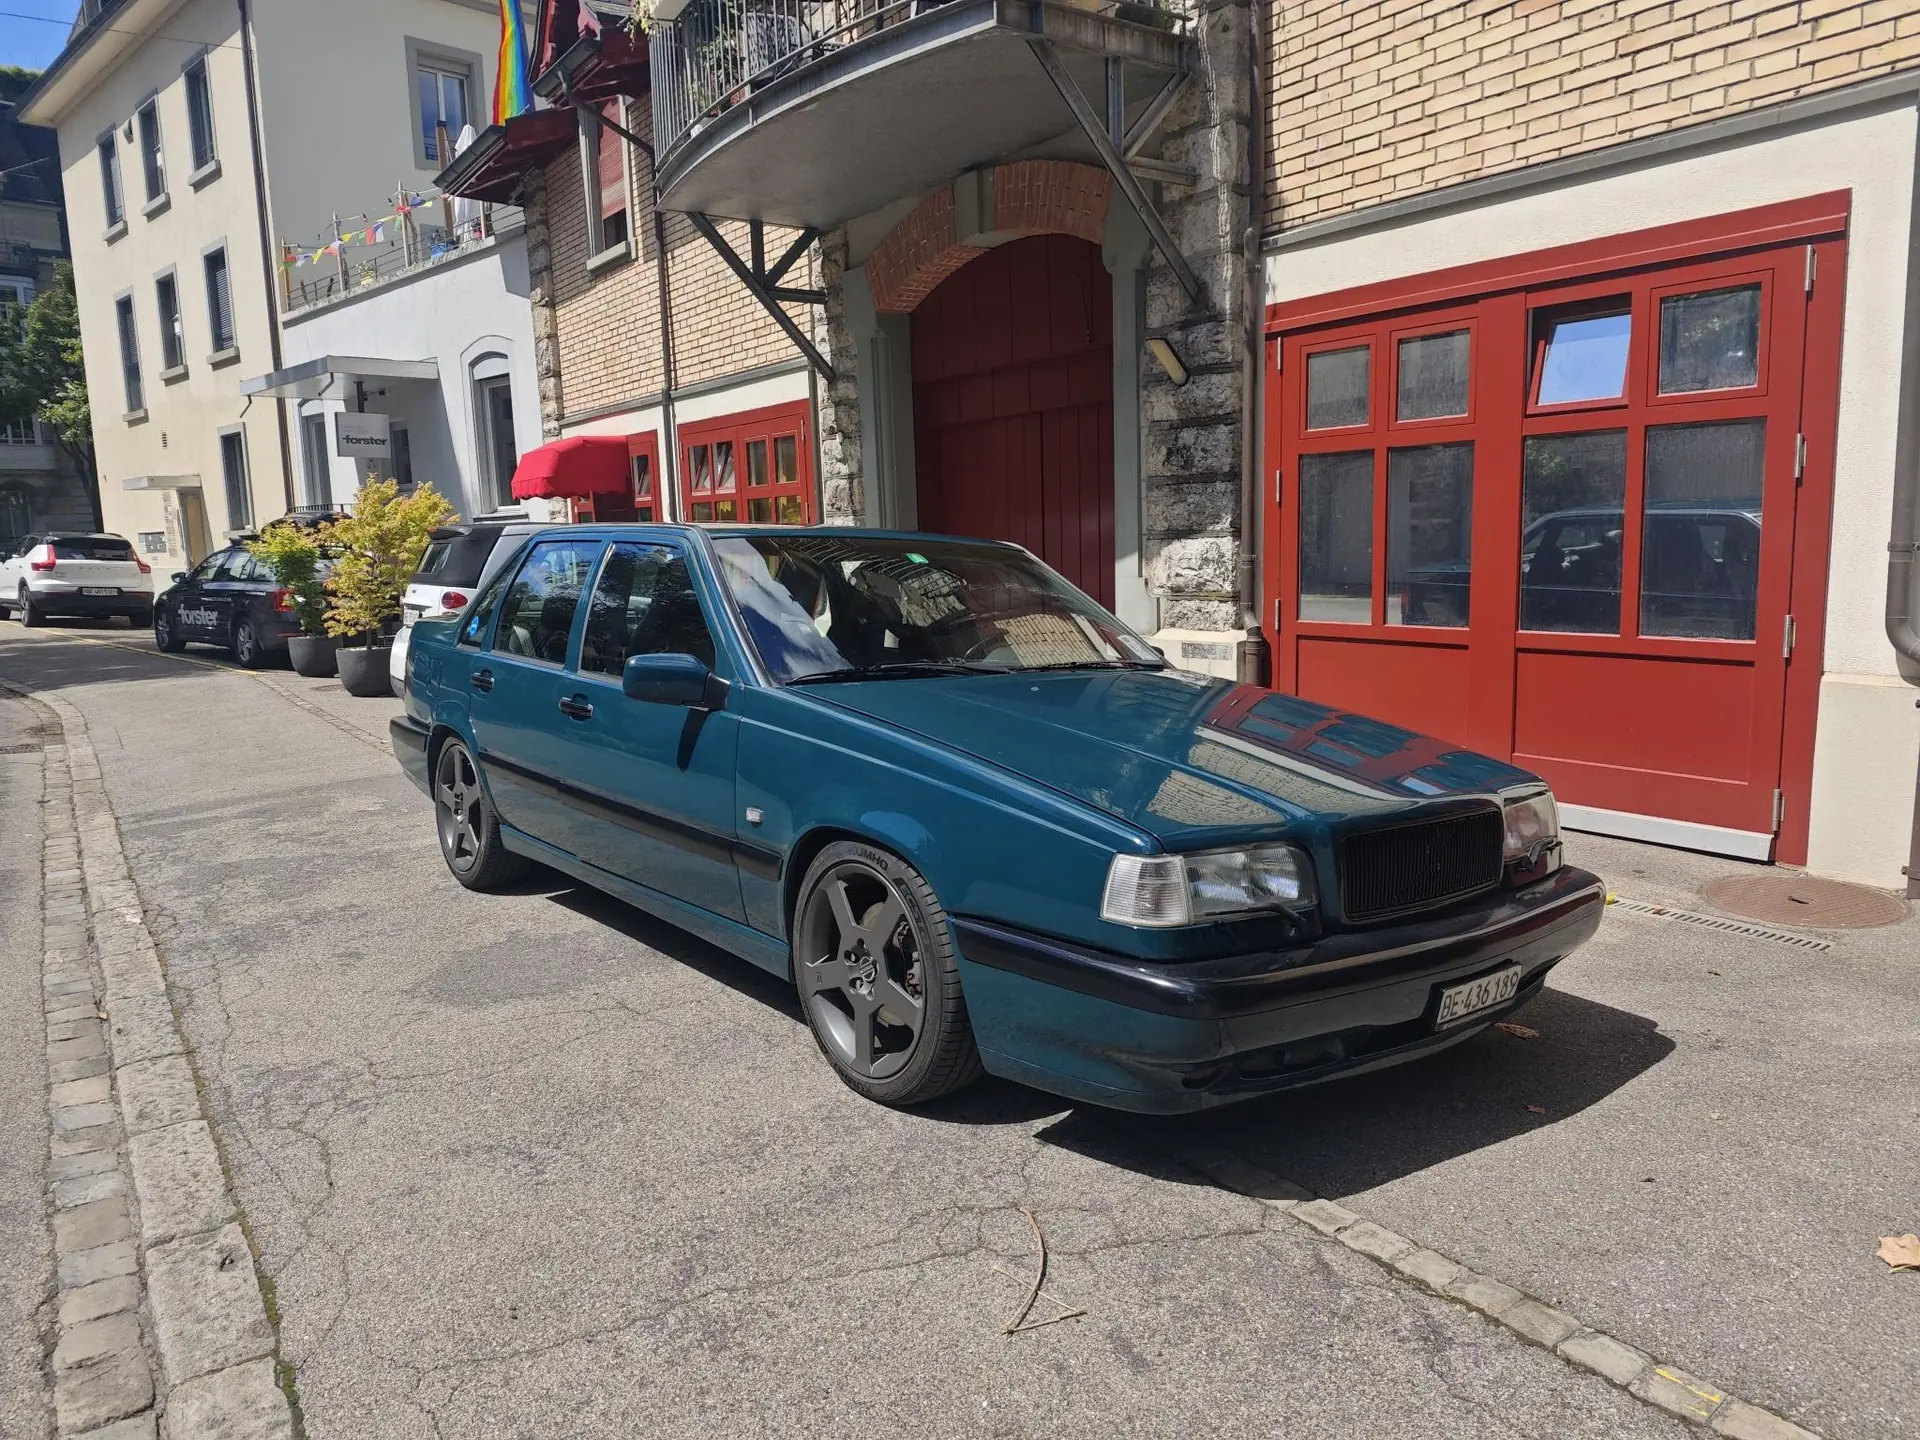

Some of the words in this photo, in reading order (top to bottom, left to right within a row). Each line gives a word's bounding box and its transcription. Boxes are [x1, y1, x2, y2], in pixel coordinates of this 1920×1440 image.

[342, 434, 388, 446] forster
[178, 603, 218, 626] forster
[848, 847, 889, 871] KUMHO
[1493, 971, 1519, 1001] 189
